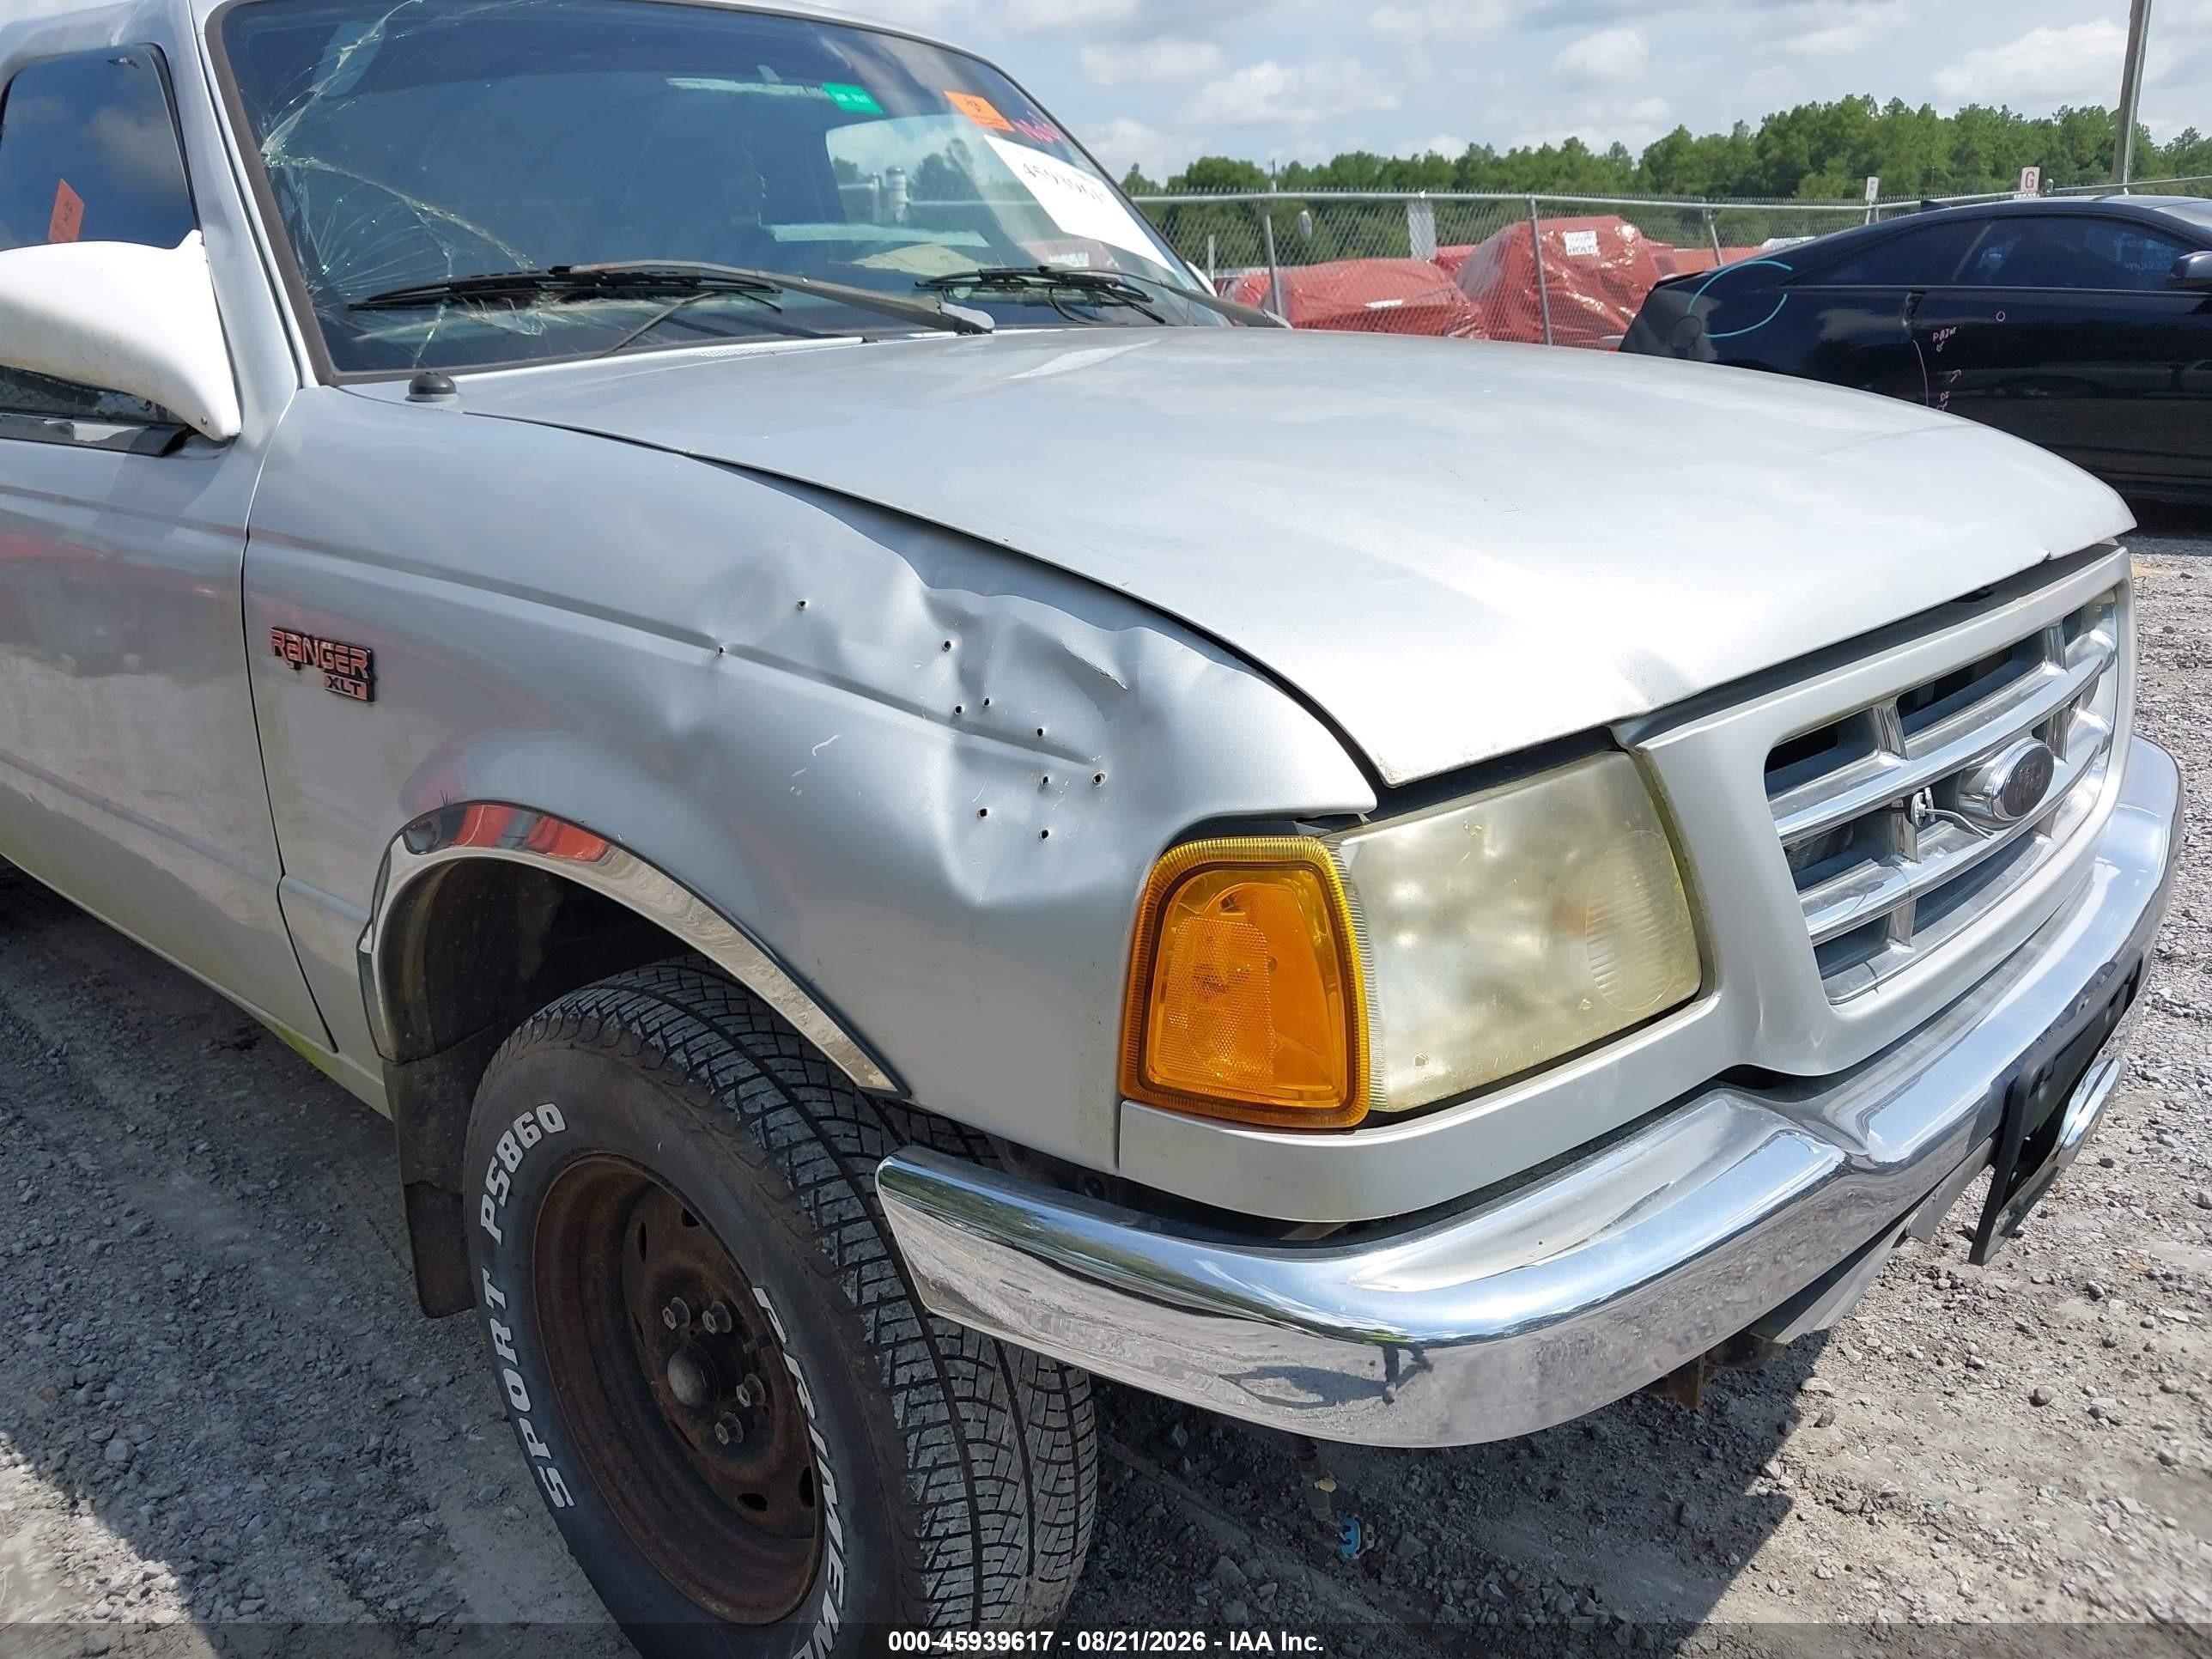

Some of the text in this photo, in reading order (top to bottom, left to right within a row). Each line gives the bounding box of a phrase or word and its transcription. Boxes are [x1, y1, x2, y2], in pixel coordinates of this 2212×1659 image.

[2025, 171, 2035, 189] G
[270, 628, 370, 679] RANGER
[326, 674, 362, 696] XLT
[480, 1103, 575, 1509] SPORT PS860
